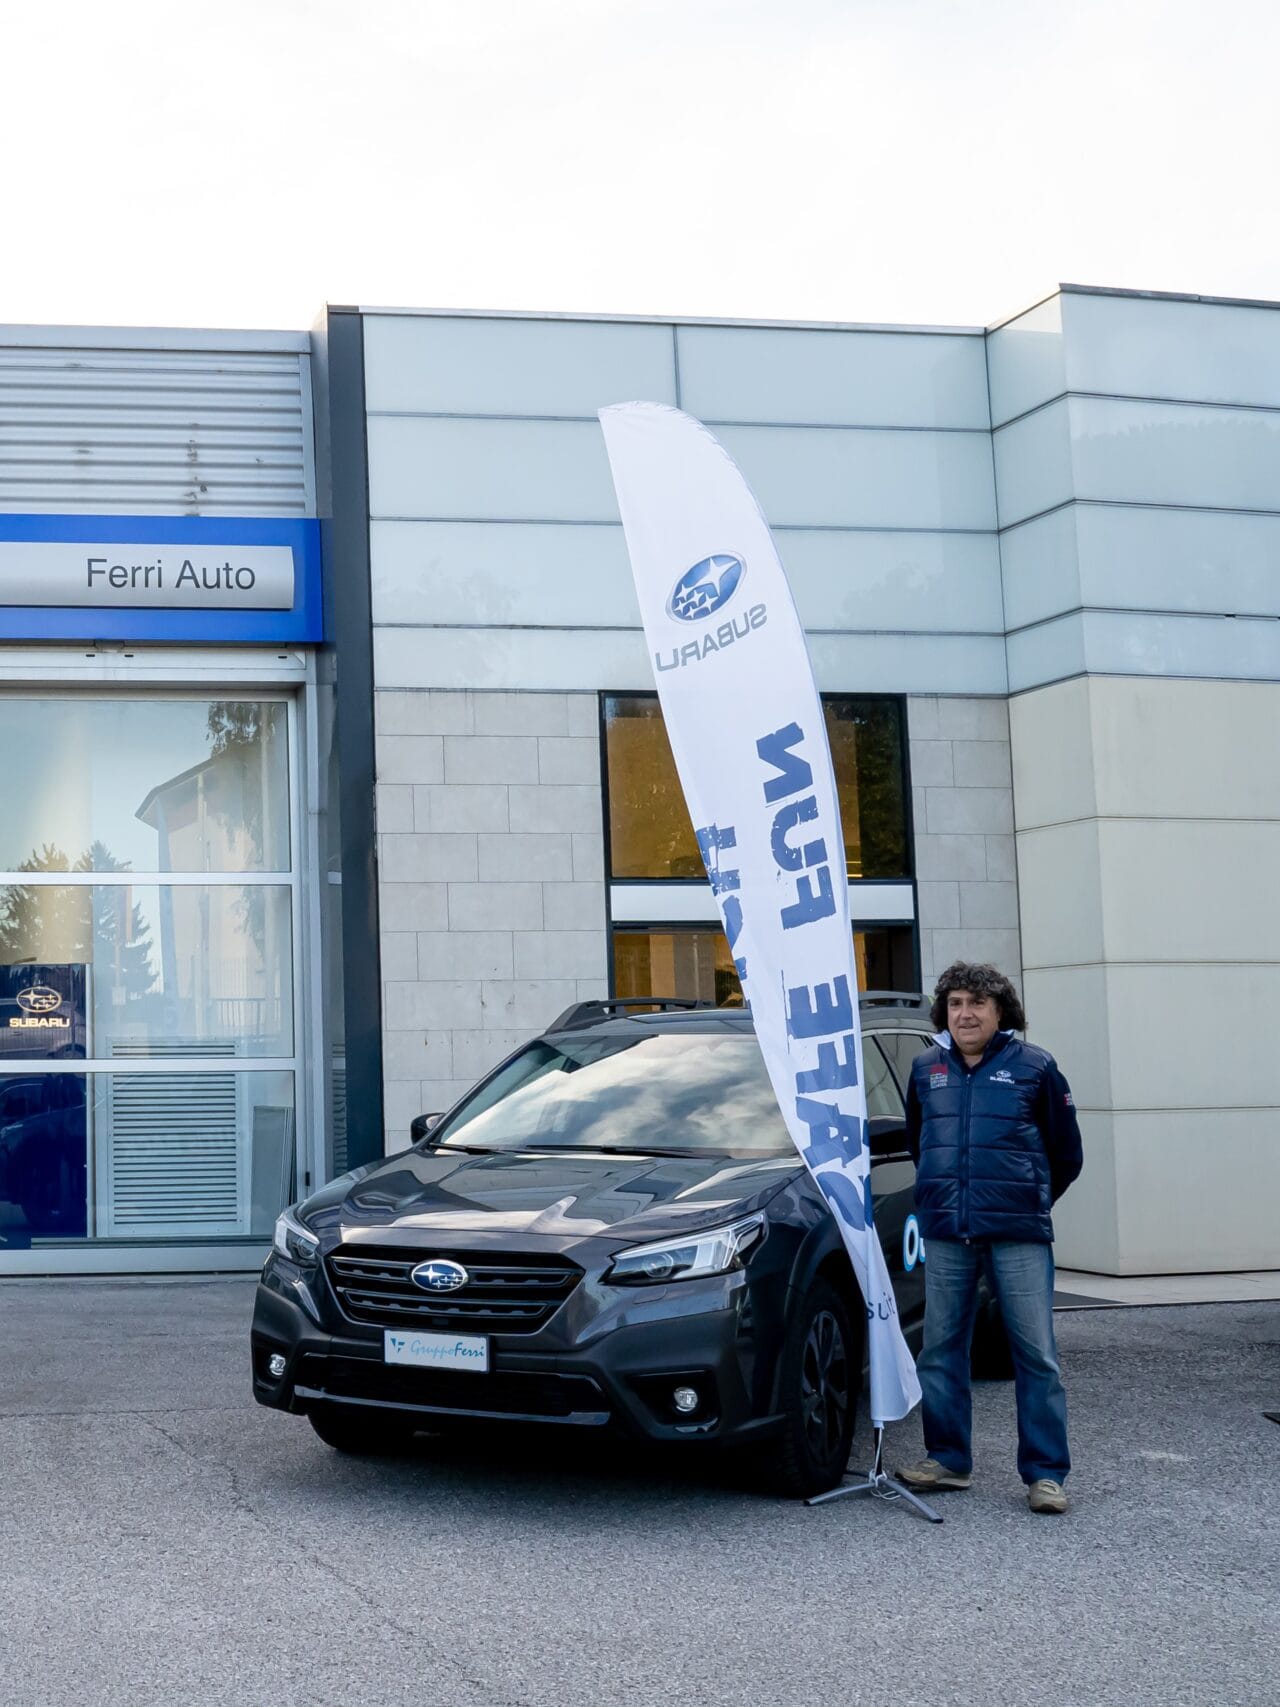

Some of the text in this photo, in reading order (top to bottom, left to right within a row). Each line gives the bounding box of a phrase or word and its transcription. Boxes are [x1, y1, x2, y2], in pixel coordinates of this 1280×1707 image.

[87, 558, 256, 590] Ferri Auto
[9, 1017, 71, 1028] SUBARU
[989, 1076, 1015, 1085] SUBARU
